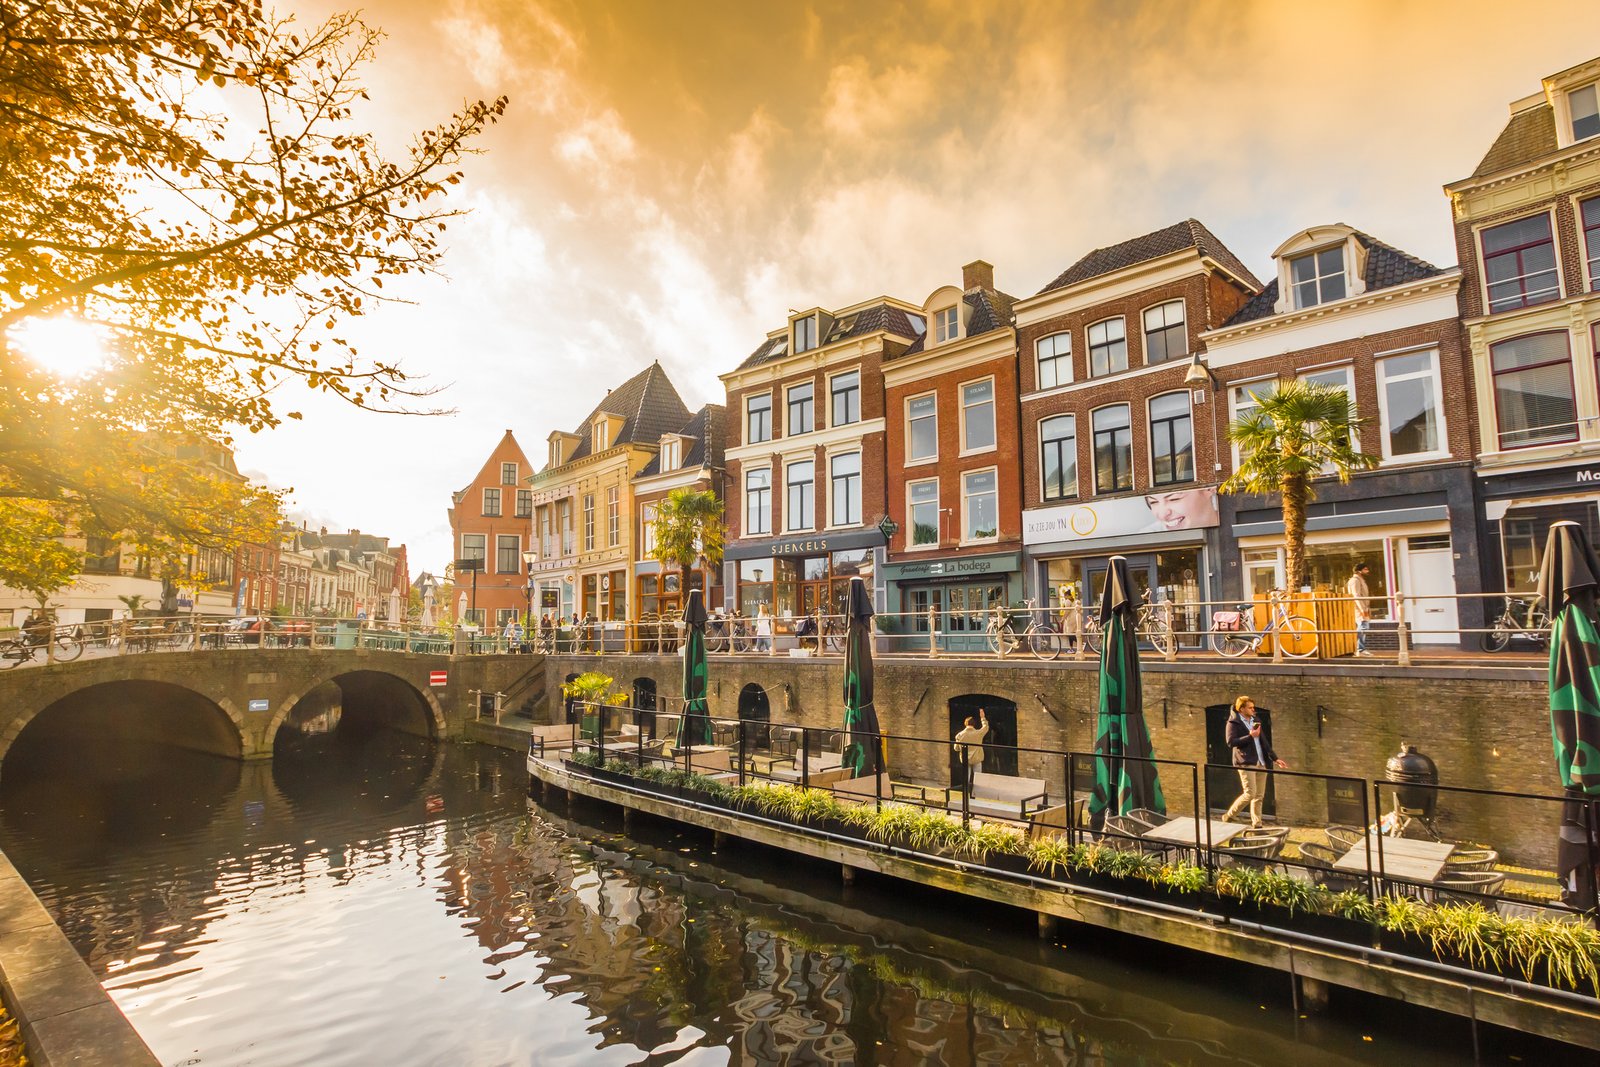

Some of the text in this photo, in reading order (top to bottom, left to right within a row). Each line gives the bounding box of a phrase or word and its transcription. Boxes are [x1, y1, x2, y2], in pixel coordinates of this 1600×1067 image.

[771, 540, 827, 555] SJENKELS
[944, 563, 955, 573] La
[957, 560, 991, 572] bodega
